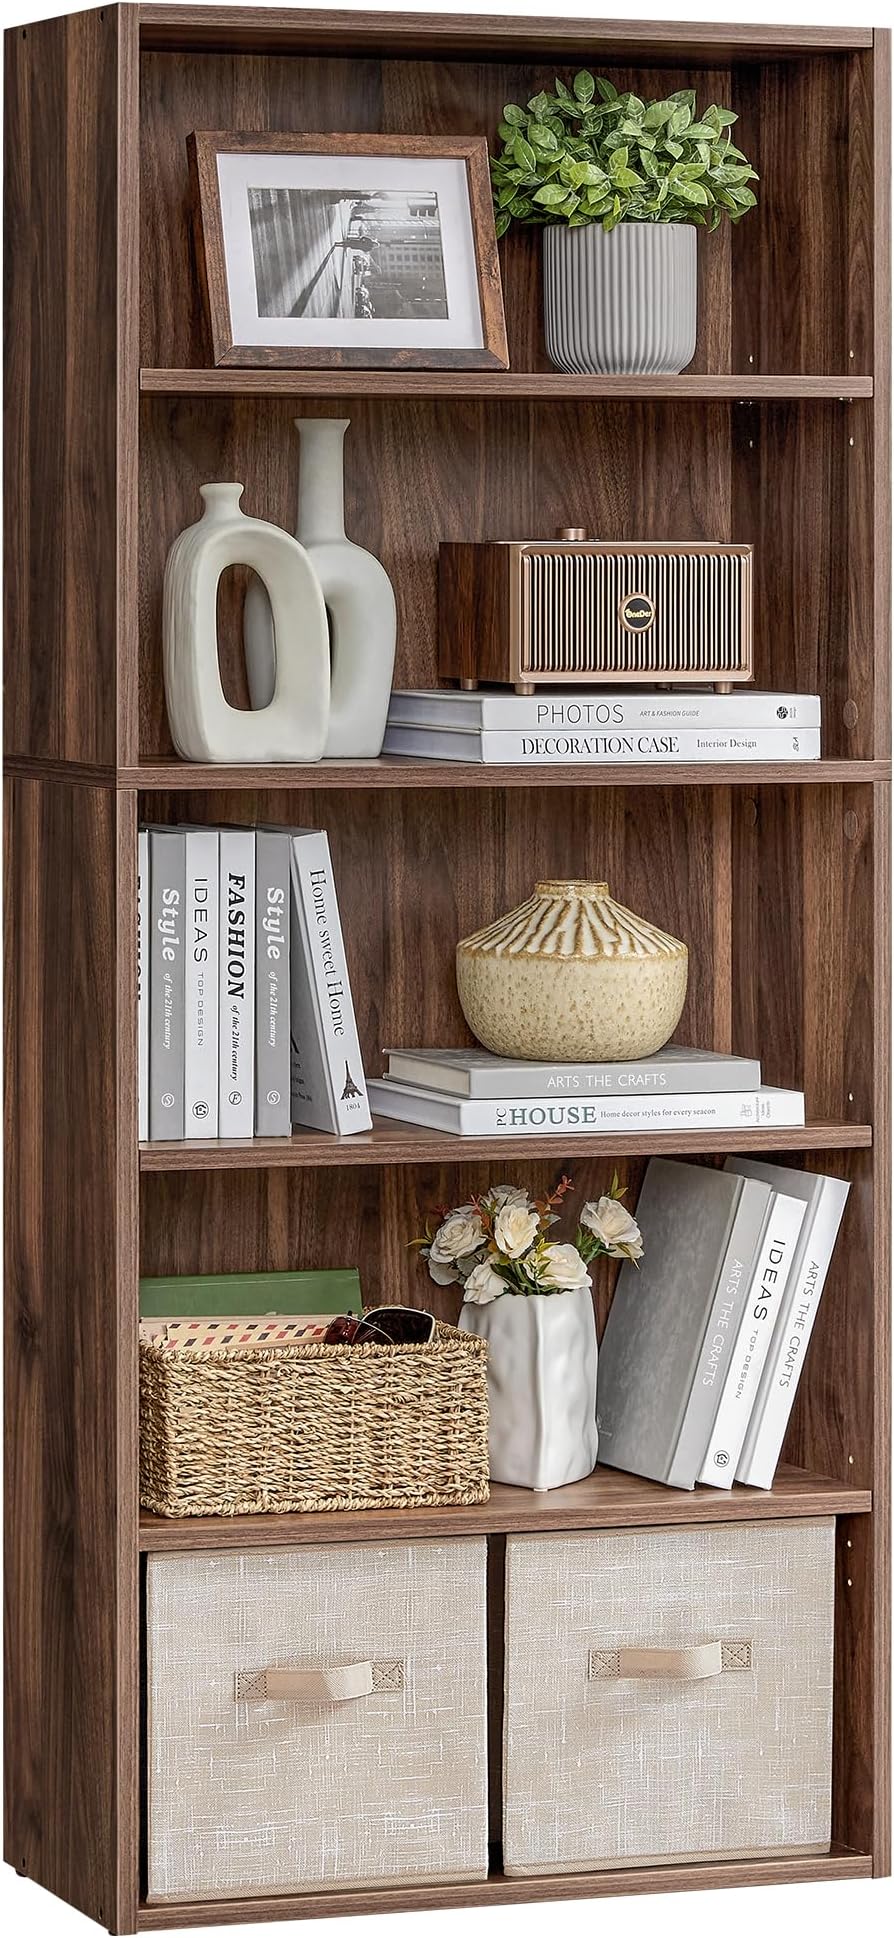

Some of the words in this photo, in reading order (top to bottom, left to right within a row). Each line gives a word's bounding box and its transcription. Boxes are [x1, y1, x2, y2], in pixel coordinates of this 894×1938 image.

[537, 704, 624, 724] PHOTOS
[639, 710, 651, 718] ART
[681, 709, 700, 717] GUIDE
[521, 737, 634, 755] DECORATION
[637, 736, 680, 754] CASE
[696, 738, 728, 748] Interior
[729, 738, 757, 749] Design
[309, 869, 327, 926] Home
[157, 888, 180, 961] Style
[193, 878, 208, 963] IDEAS
[262, 887, 285, 960] Style
[227, 872, 246, 1000] FASHION
[318, 930, 337, 976] sweet
[162, 972, 173, 984] of
[164, 984, 173, 999] the
[267, 971, 279, 982] of
[269, 982, 278, 996] the
[229, 1005, 241, 1016] of
[231, 1016, 240, 1030] the
[326, 980, 345, 1037] Home
[162, 1018, 172, 1050] century
[268, 1016, 277, 1048] century
[229, 1050, 238, 1081] century
[546, 1075, 580, 1089] ARTS
[585, 1074, 612, 1088] THE
[617, 1073, 667, 1087] CRAFTS
[508, 1106, 597, 1126] HOUSE
[600, 1110, 621, 1118] Home
[621, 1110, 641, 1118] decor
[641, 1108, 662, 1119] styles
[662, 1108, 673, 1116] for
[673, 1109, 691, 1118] every
[726, 1258, 744, 1295] ARTS
[753, 1239, 786, 1321] IDEAS
[802, 1260, 820, 1296] ARTS
[717, 1300, 735, 1329] THE
[794, 1303, 811, 1331] THE
[748, 1328, 760, 1353] TOP
[702, 1334, 725, 1387] CRAFTS
[779, 1336, 801, 1388] CRAFTS
[735, 1354, 751, 1400] DESIGN
